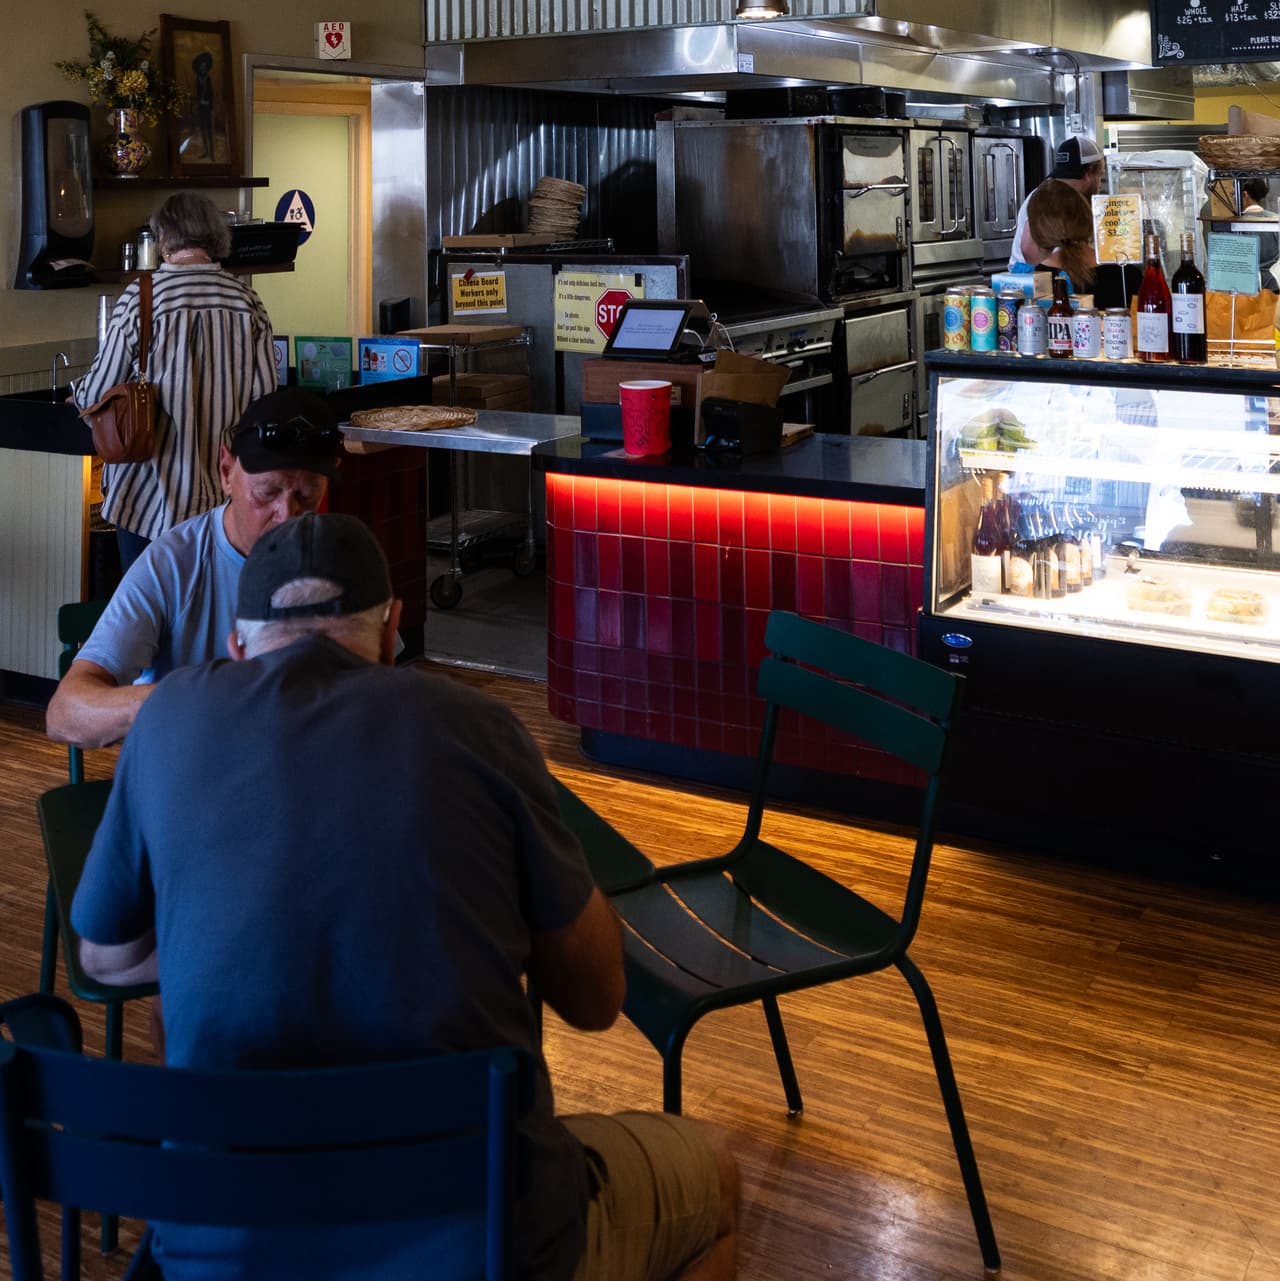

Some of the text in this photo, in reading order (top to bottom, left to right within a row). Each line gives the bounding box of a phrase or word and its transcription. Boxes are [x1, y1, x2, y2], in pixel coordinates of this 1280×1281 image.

[1184, 7, 1208, 16] WHOLE
[1231, 4, 1249, 13] HALF
[324, 22, 345, 31] AED
[481, 277, 499, 286] Board
[460, 288, 498, 297] Workers only
[455, 298, 504, 309] beyond this point
[598, 304, 624, 324] ST
[1048, 322, 1072, 340] IPA
